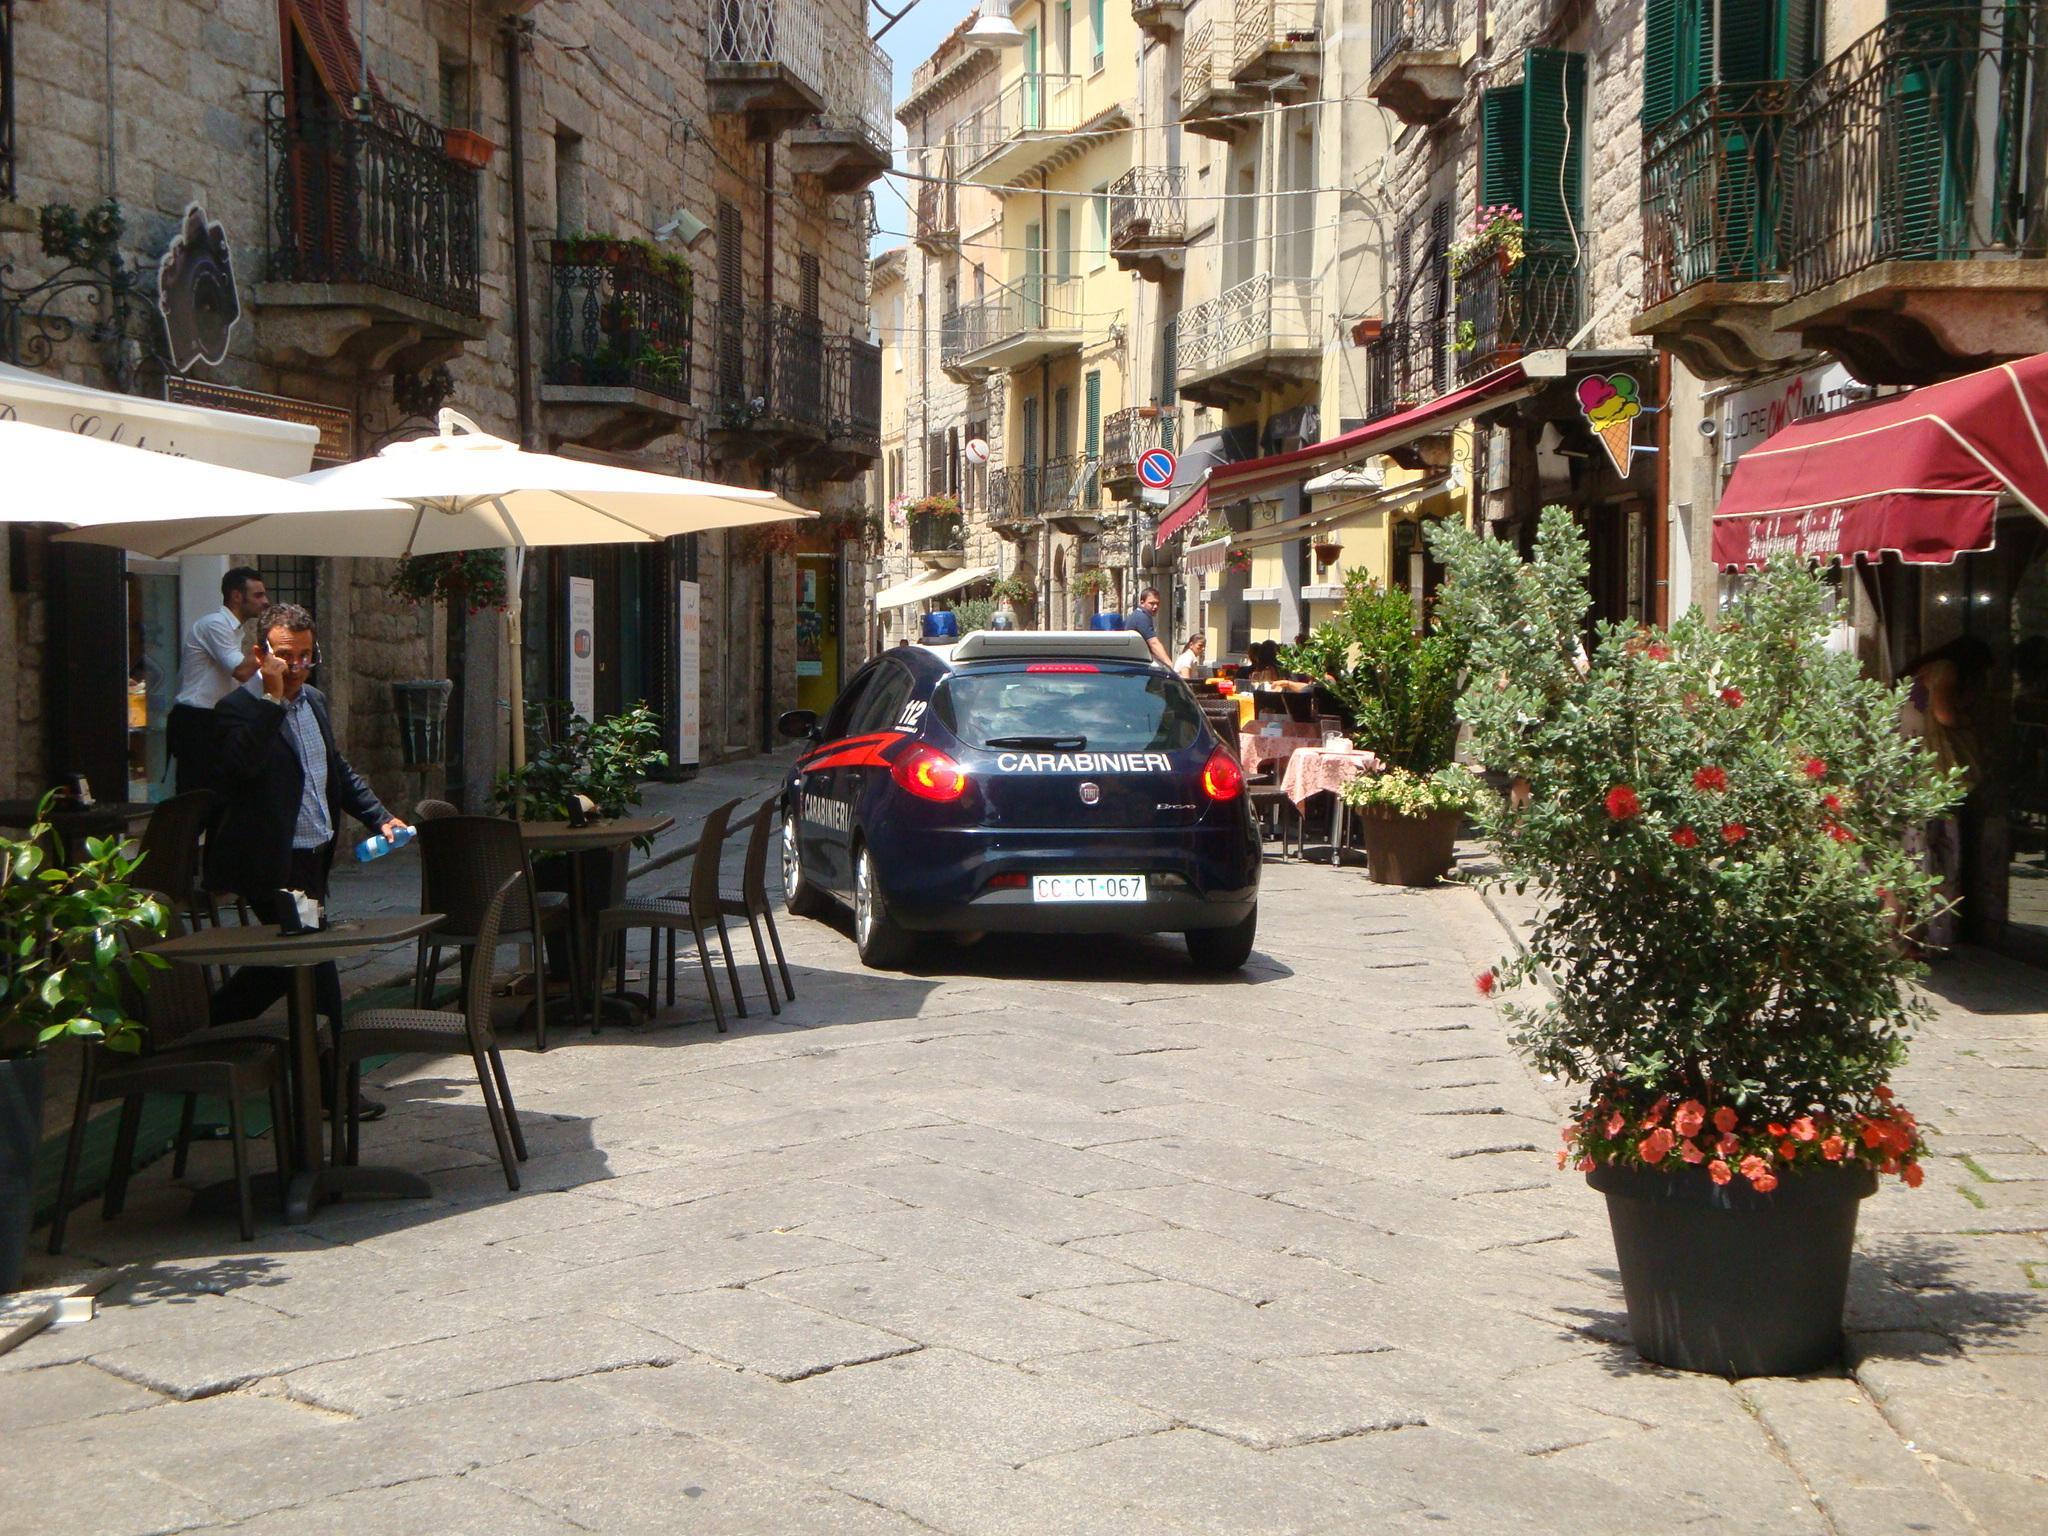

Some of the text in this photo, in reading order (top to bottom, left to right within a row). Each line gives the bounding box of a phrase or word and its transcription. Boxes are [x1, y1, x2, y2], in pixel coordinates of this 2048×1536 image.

[898, 699, 928, 726] 112
[997, 752, 1172, 772] CARABINIERI
[1083, 788, 1098, 799] FIAT
[804, 792, 849, 833] CARABINIERI
[1037, 878, 1141, 898] CC CT 067
